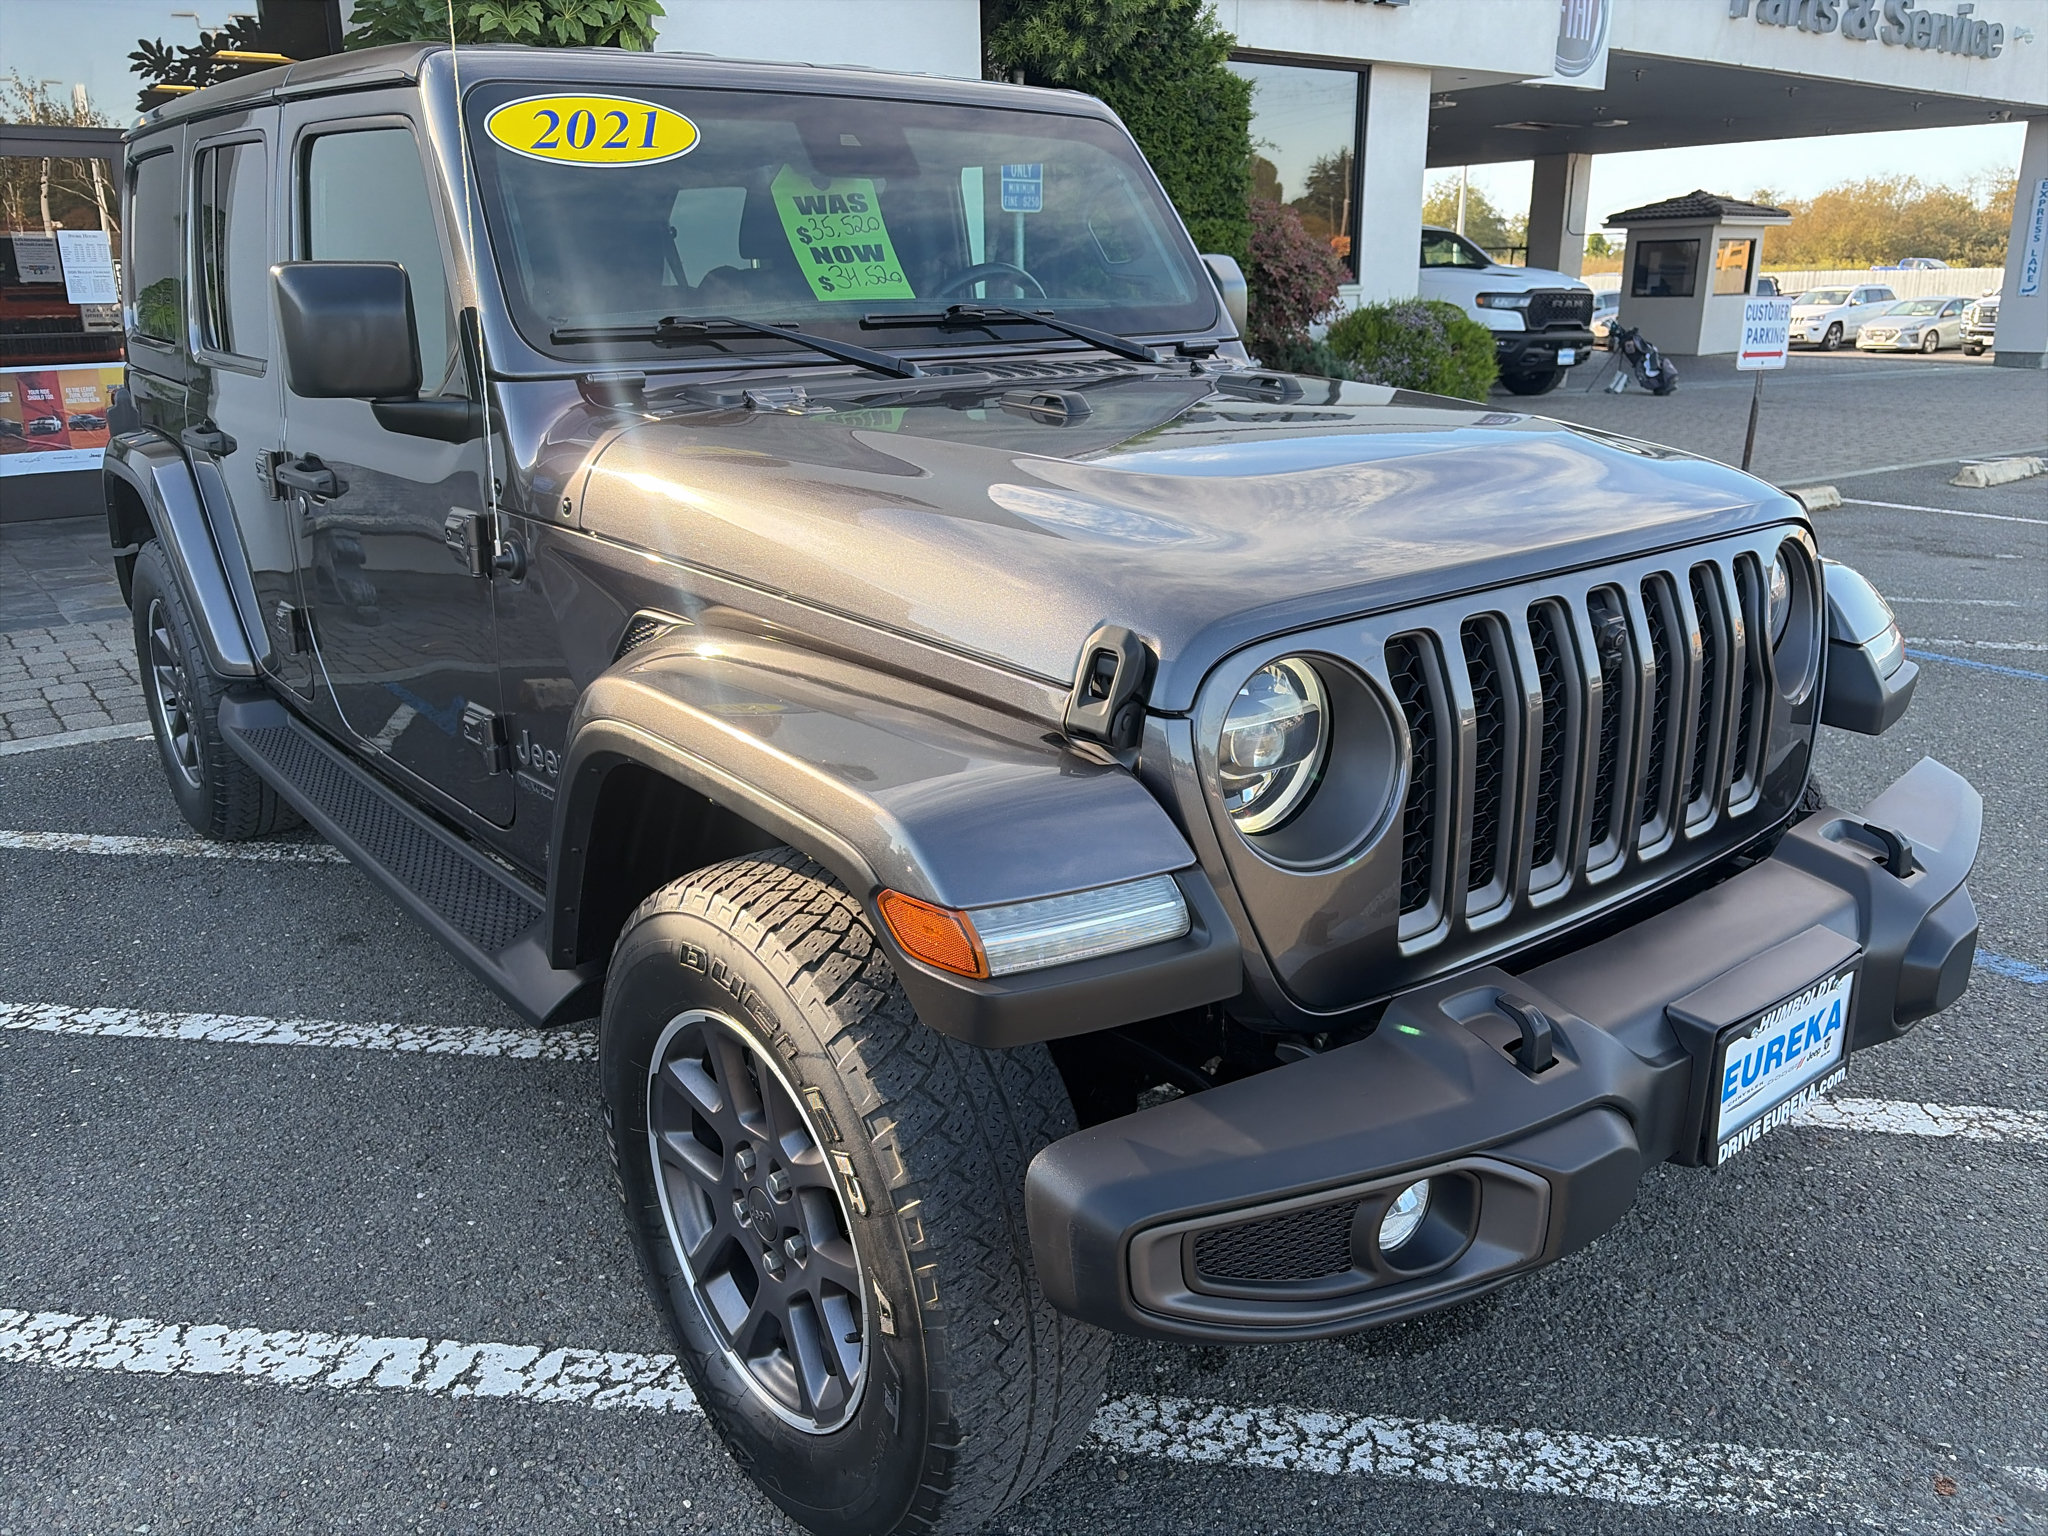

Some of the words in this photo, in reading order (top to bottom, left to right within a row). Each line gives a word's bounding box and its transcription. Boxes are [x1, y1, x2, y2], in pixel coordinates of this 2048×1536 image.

[1561, 0, 1593, 41] IAT
[1841, 0, 1881, 41] &
[1880, 0, 2004, 59] Service
[530, 109, 660, 149] 2021
[1010, 164, 1033, 178] ONLY
[1004, 195, 1018, 207] FINE
[1008, 183, 1036, 194] MINIMUM
[792, 193, 869, 216] WAS
[2032, 181, 2048, 243] EXPRESS
[796, 215, 880, 245] $35,520
[809, 244, 886, 265] NOW
[2026, 249, 2038, 283] LANE
[818, 265, 902, 292] $34,520
[1552, 299, 1584, 309] RAM
[1745, 303, 1790, 322] CUSTOMER
[1746, 327, 1786, 345] PARKING
[516, 730, 560, 778] Jee
[1759, 975, 1837, 1032] HUMBOLDT
[1722, 999, 1841, 1103] EUREKA
[1727, 1081, 1764, 1107] CHRYSLER
[1806, 1048, 1821, 1062] Jeep
